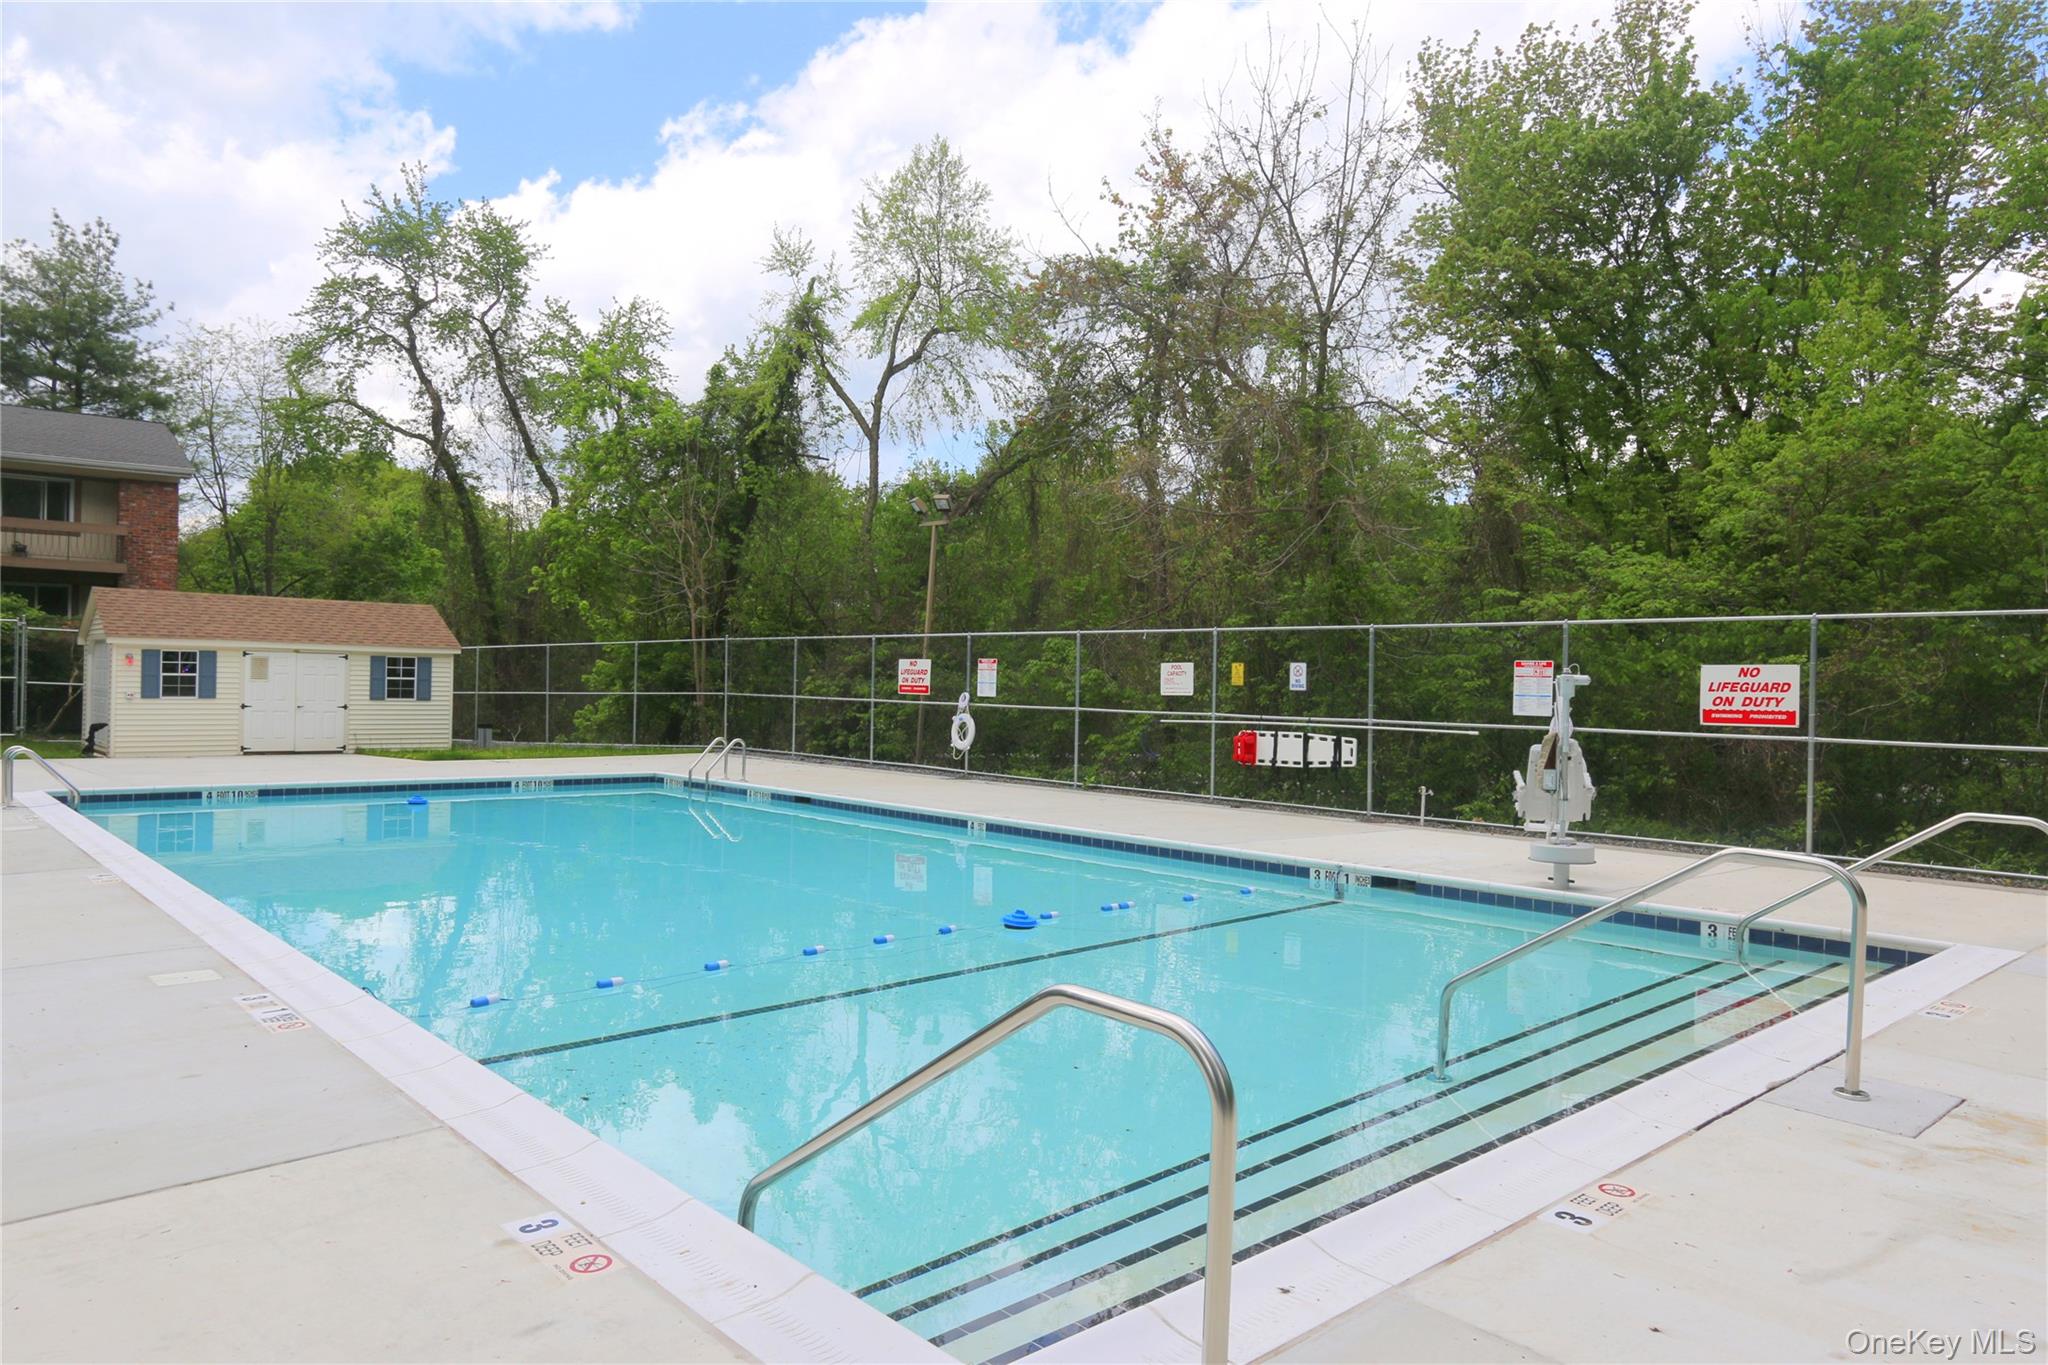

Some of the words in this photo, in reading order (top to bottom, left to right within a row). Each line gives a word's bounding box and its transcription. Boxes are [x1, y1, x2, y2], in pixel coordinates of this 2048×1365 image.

[1738, 667, 1761, 678] NO
[1708, 682, 1792, 693] LIFEGUARD
[1712, 696, 1735, 707] ON
[1741, 697, 1785, 707] DUTY
[1314, 869, 1321, 880] 3
[1708, 923, 1718, 937] 3
[1554, 1211, 1593, 1226] 3
[518, 1219, 559, 1234] 3
